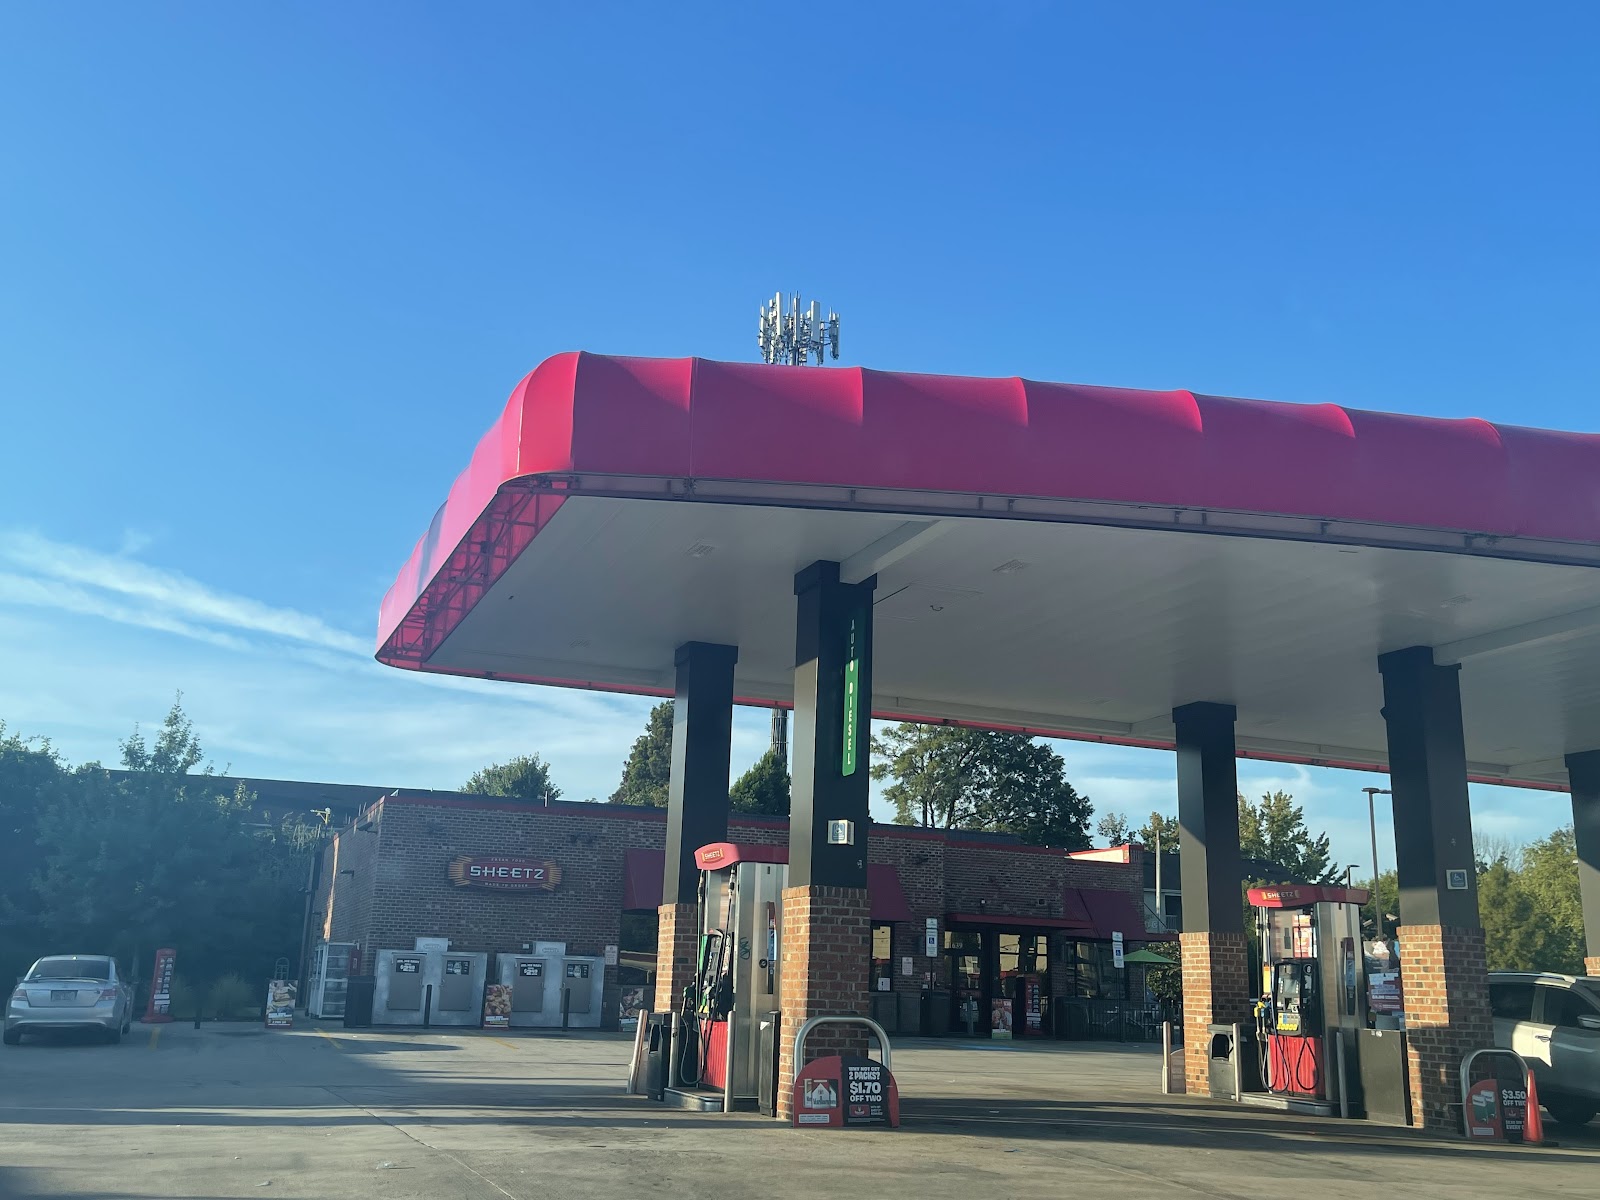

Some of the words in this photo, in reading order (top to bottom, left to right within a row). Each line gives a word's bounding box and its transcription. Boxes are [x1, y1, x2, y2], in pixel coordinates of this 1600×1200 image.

[470, 866, 544, 879] SHEETZ
[849, 1072, 854, 1080] 2
[854, 1072, 880, 1080] PACKS?
[849, 1082, 881, 1095] $1.70
[1502, 1089, 1526, 1100] $3.50
